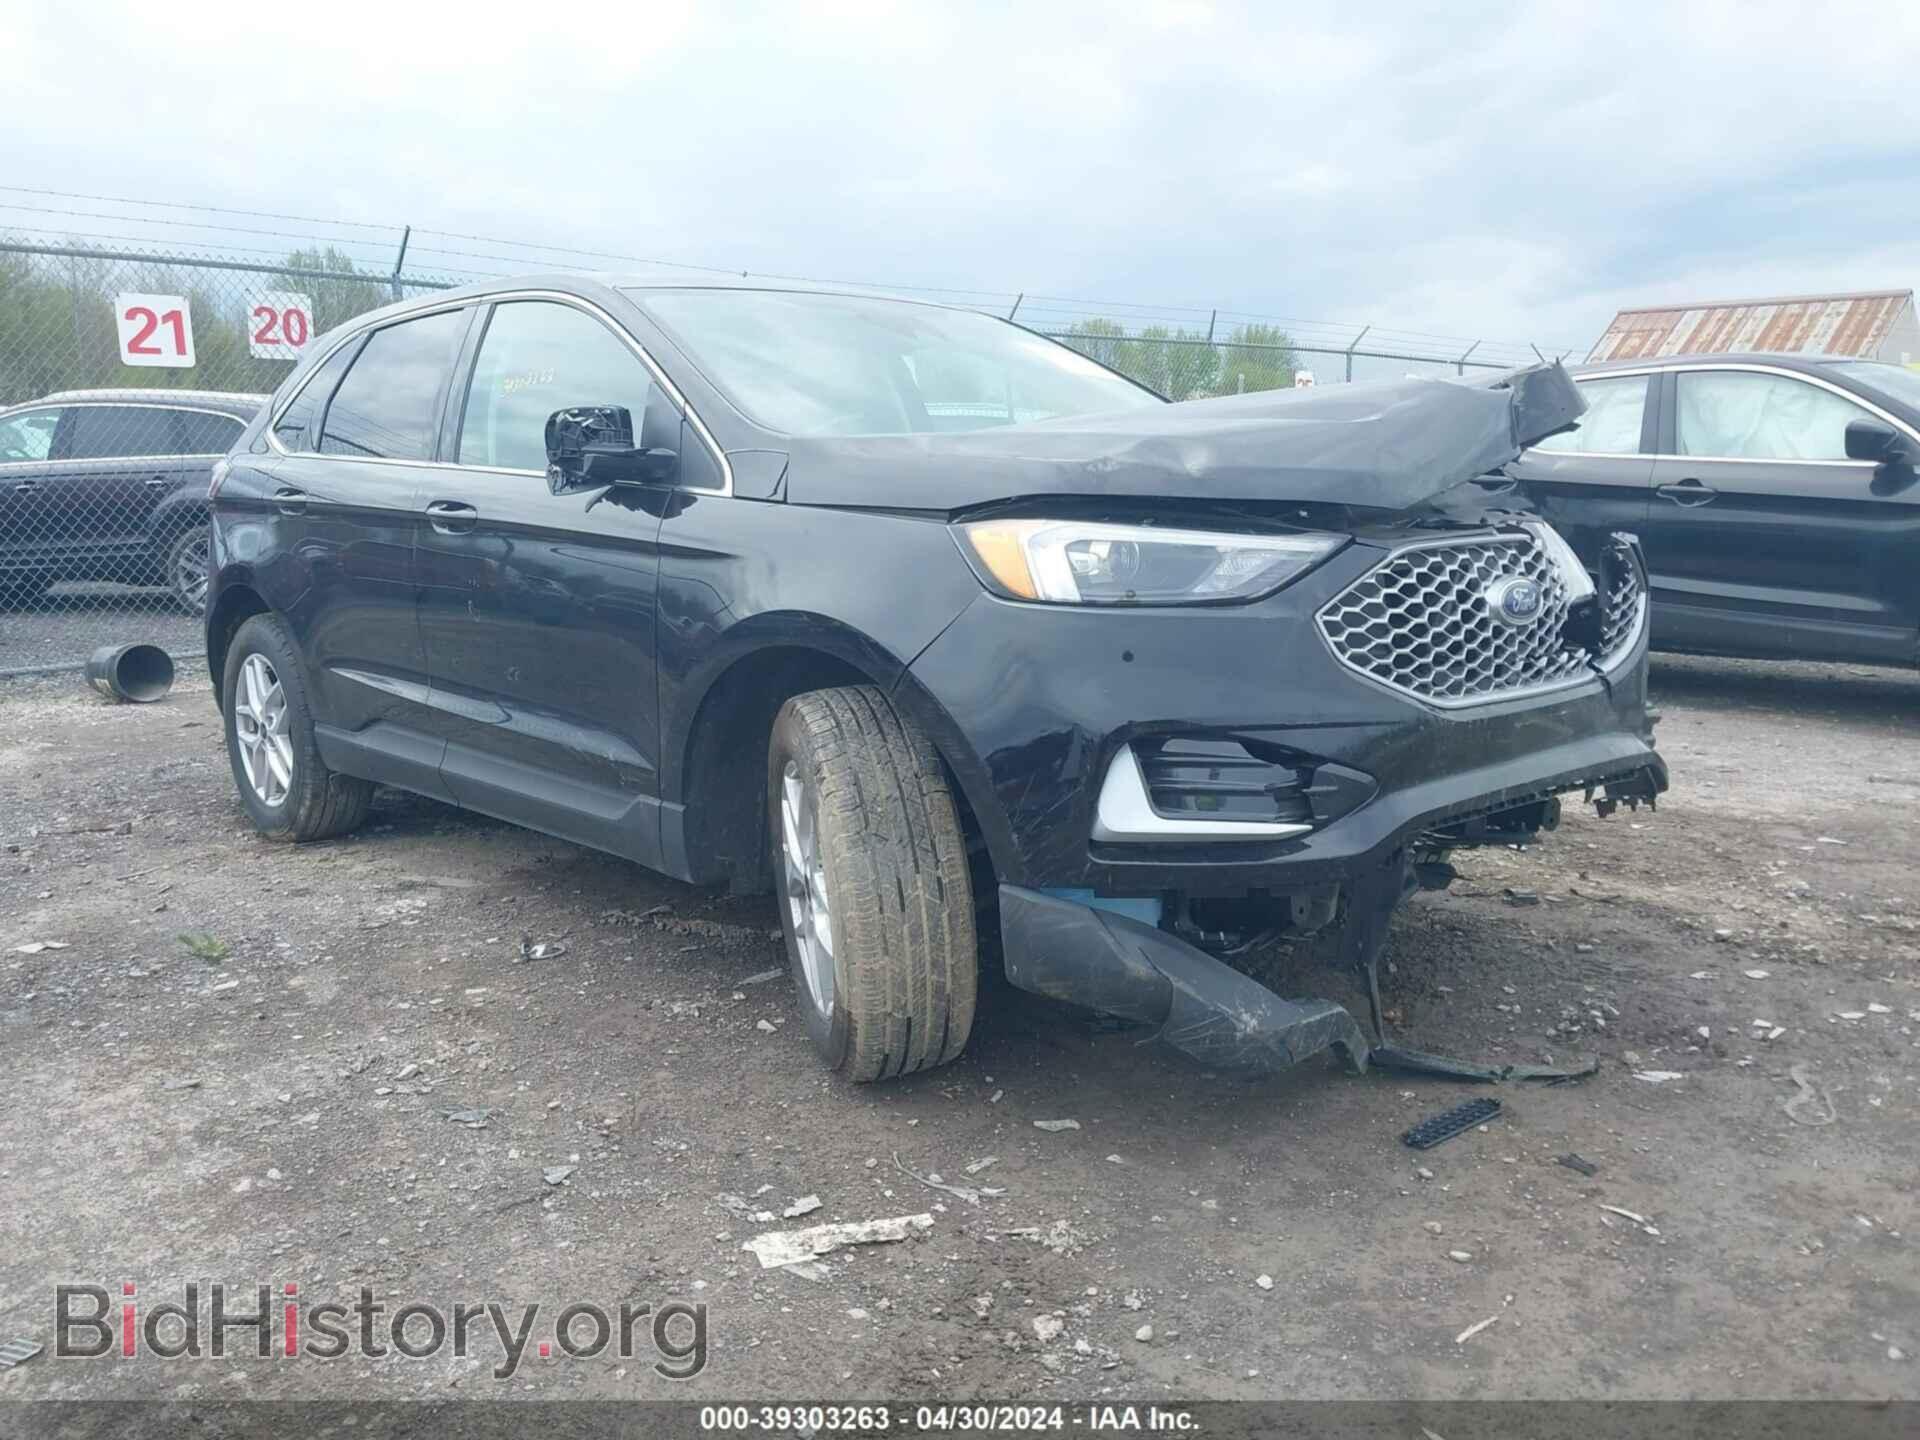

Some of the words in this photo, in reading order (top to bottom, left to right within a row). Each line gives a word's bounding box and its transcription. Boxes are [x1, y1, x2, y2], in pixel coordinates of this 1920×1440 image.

[125, 307, 187, 356] 21
[254, 306, 308, 347] 20
[1512, 588, 1537, 613] Ford
